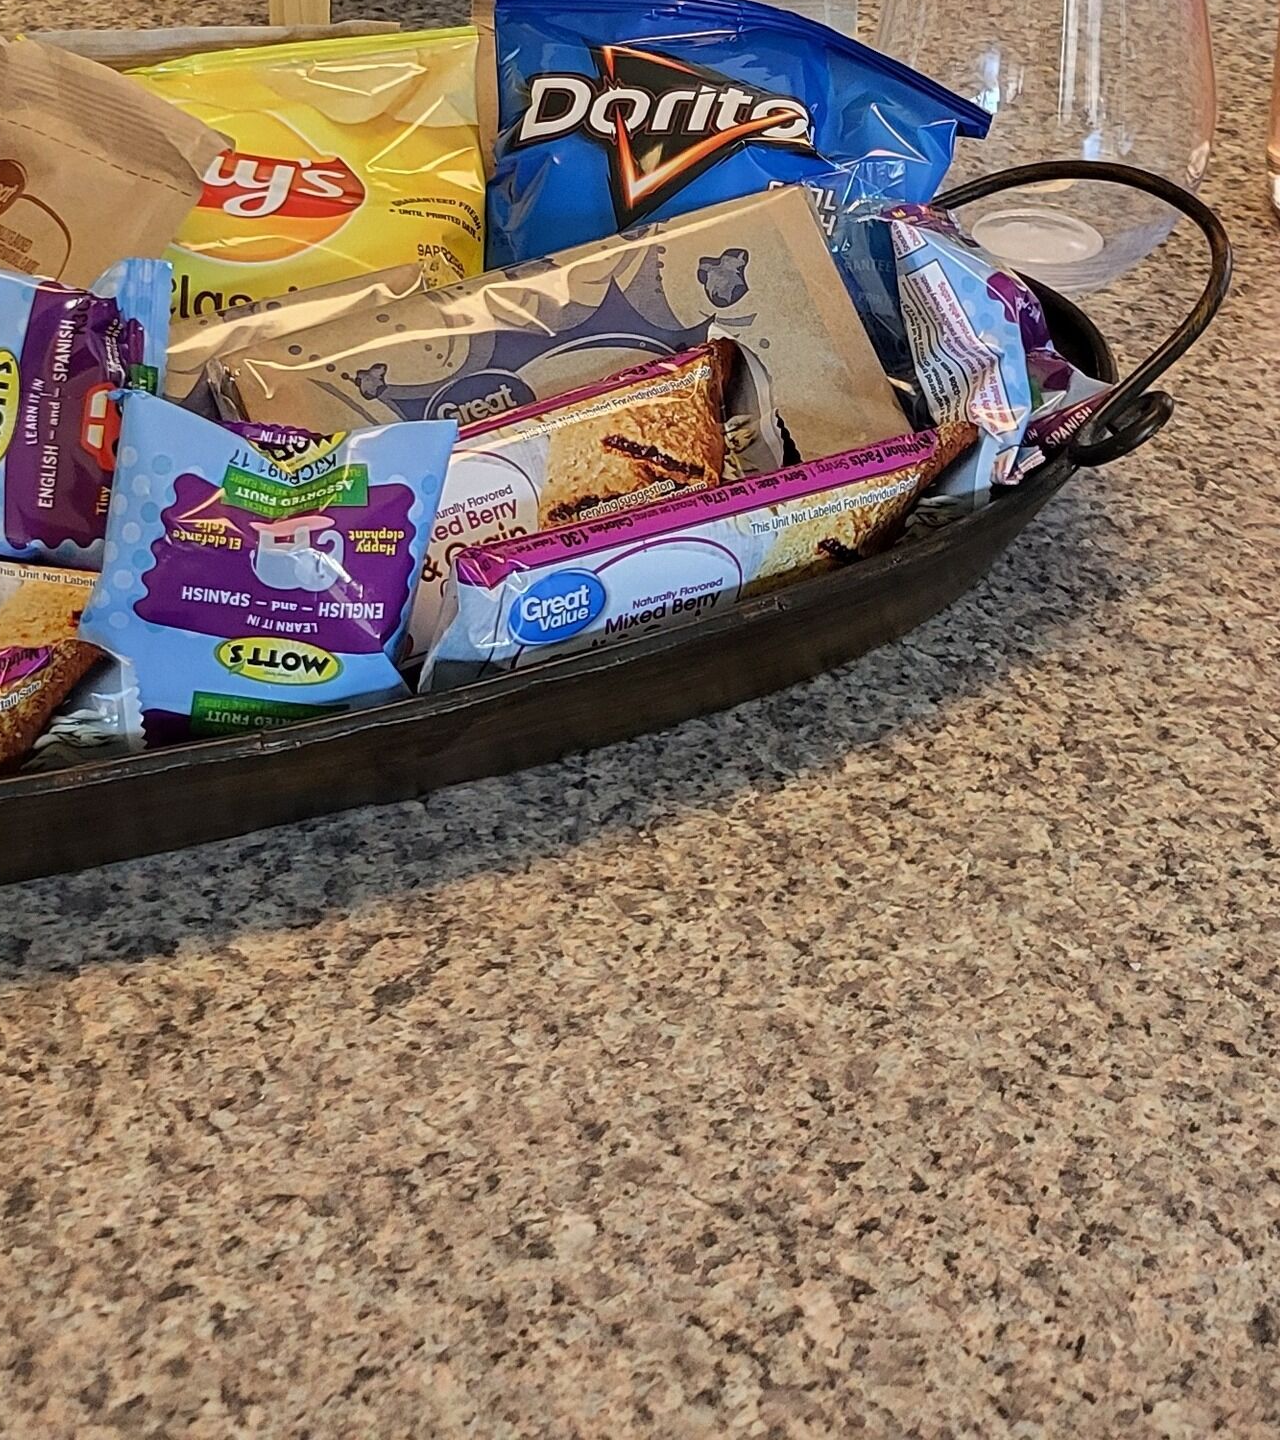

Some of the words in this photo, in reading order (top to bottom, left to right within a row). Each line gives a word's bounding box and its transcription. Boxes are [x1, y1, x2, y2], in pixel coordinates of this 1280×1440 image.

[519, 76, 811, 141] Dorito
[459, 201, 481, 230] FRESH
[51, 318, 77, 383] SPANISH
[31, 377, 46, 391] IN
[671, 373, 694, 390] Retail
[28, 392, 42, 404] IT
[437, 383, 517, 424] Great
[45, 399, 62, 426] and
[22, 404, 42, 446] LEARN
[1045, 406, 1093, 448] SPANISH
[849, 450, 884, 466] Facts
[885, 434, 933, 458] Nutrition
[36, 443, 62, 508] ENGLISH
[95, 485, 113, 516] Tiny
[235, 486, 277, 506] FRUIT
[281, 479, 355, 507] ASSORTED
[467, 484, 513, 510] Flavored
[580, 501, 618, 521] serving
[619, 480, 674, 506] suggestion
[730, 486, 749, 497] bar
[467, 499, 517, 532] Berry
[751, 521, 770, 535] This
[771, 515, 789, 530] Unit
[791, 511, 806, 524] Not
[808, 501, 842, 519] Labeled
[859, 487, 897, 506] Individual
[347, 525, 405, 544] elephant
[588, 516, 633, 534] Calories
[171, 526, 227, 549] elefante
[227, 536, 242, 550] El
[355, 538, 397, 558] Happy
[18, 569, 39, 580] Unit
[42, 573, 61, 583] Not
[63, 575, 97, 588] Labele
[180, 584, 251, 610] SPANISH
[523, 584, 590, 621] Great
[633, 591, 677, 609] Naturally
[680, 577, 723, 600] Flavored
[270, 598, 298, 615] and
[318, 600, 385, 620] ENGLISH
[605, 602, 666, 635] Mixed
[672, 591, 721, 615] Berry
[246, 612, 261, 628] IN
[262, 619, 274, 631] IT
[276, 618, 318, 636] LEARN
[539, 607, 588, 631] Value
[203, 707, 250, 728] FRUIT
